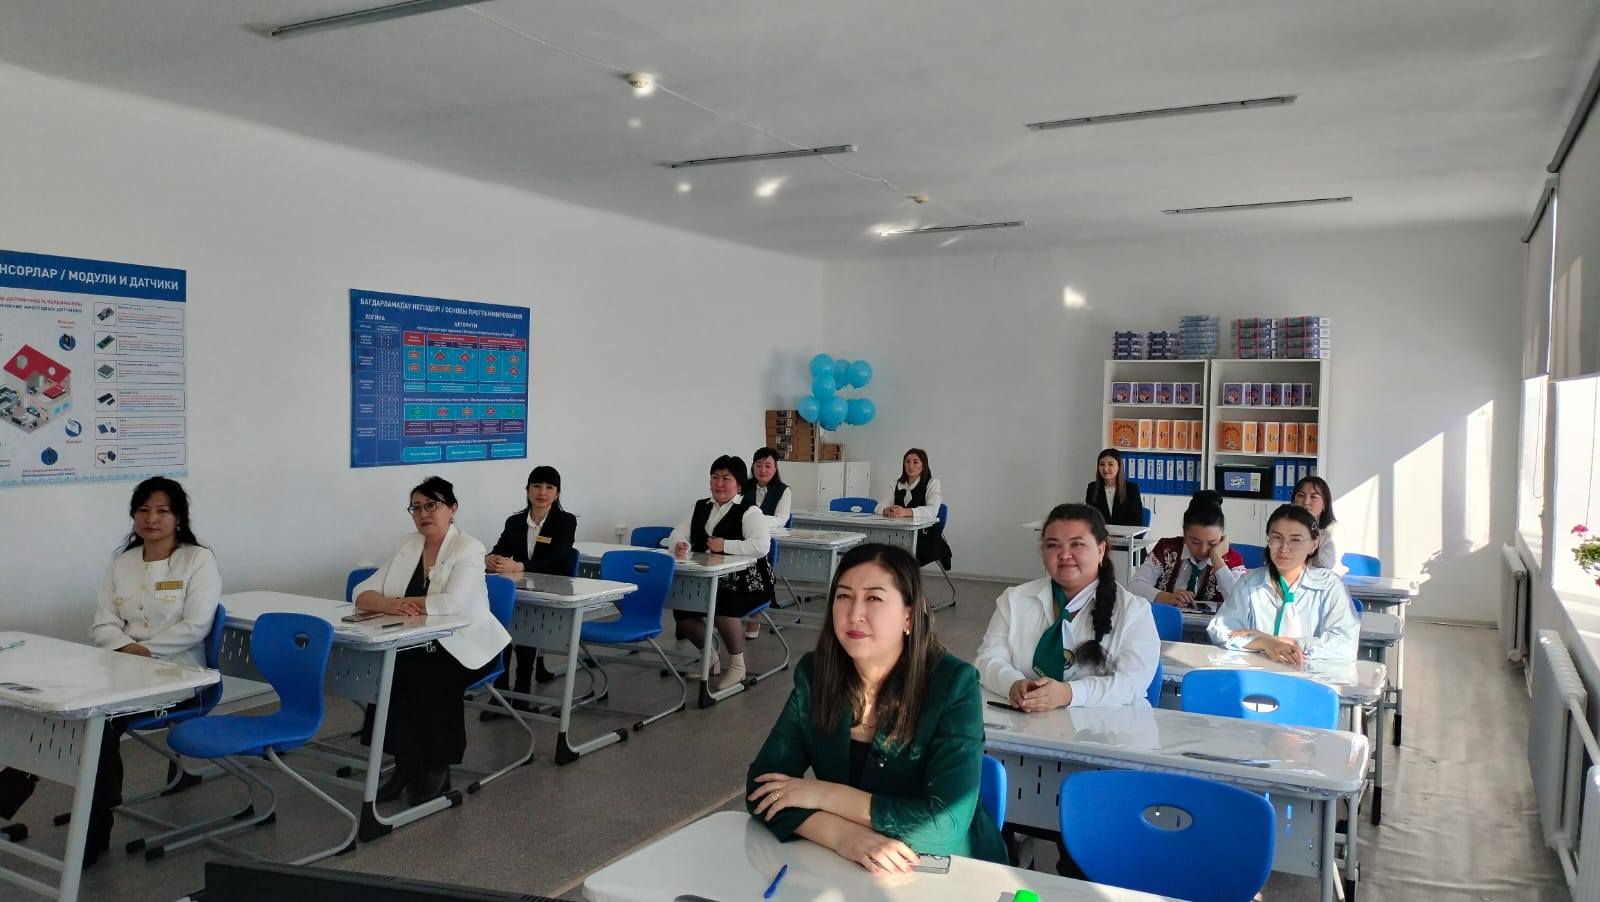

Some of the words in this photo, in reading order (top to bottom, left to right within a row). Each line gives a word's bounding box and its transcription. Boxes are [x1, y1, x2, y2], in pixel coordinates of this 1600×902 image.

[68, 270, 117, 285] МОДУЛИ
[119, 275, 128, 286] И
[129, 276, 179, 291] ДАТЧИКИ
